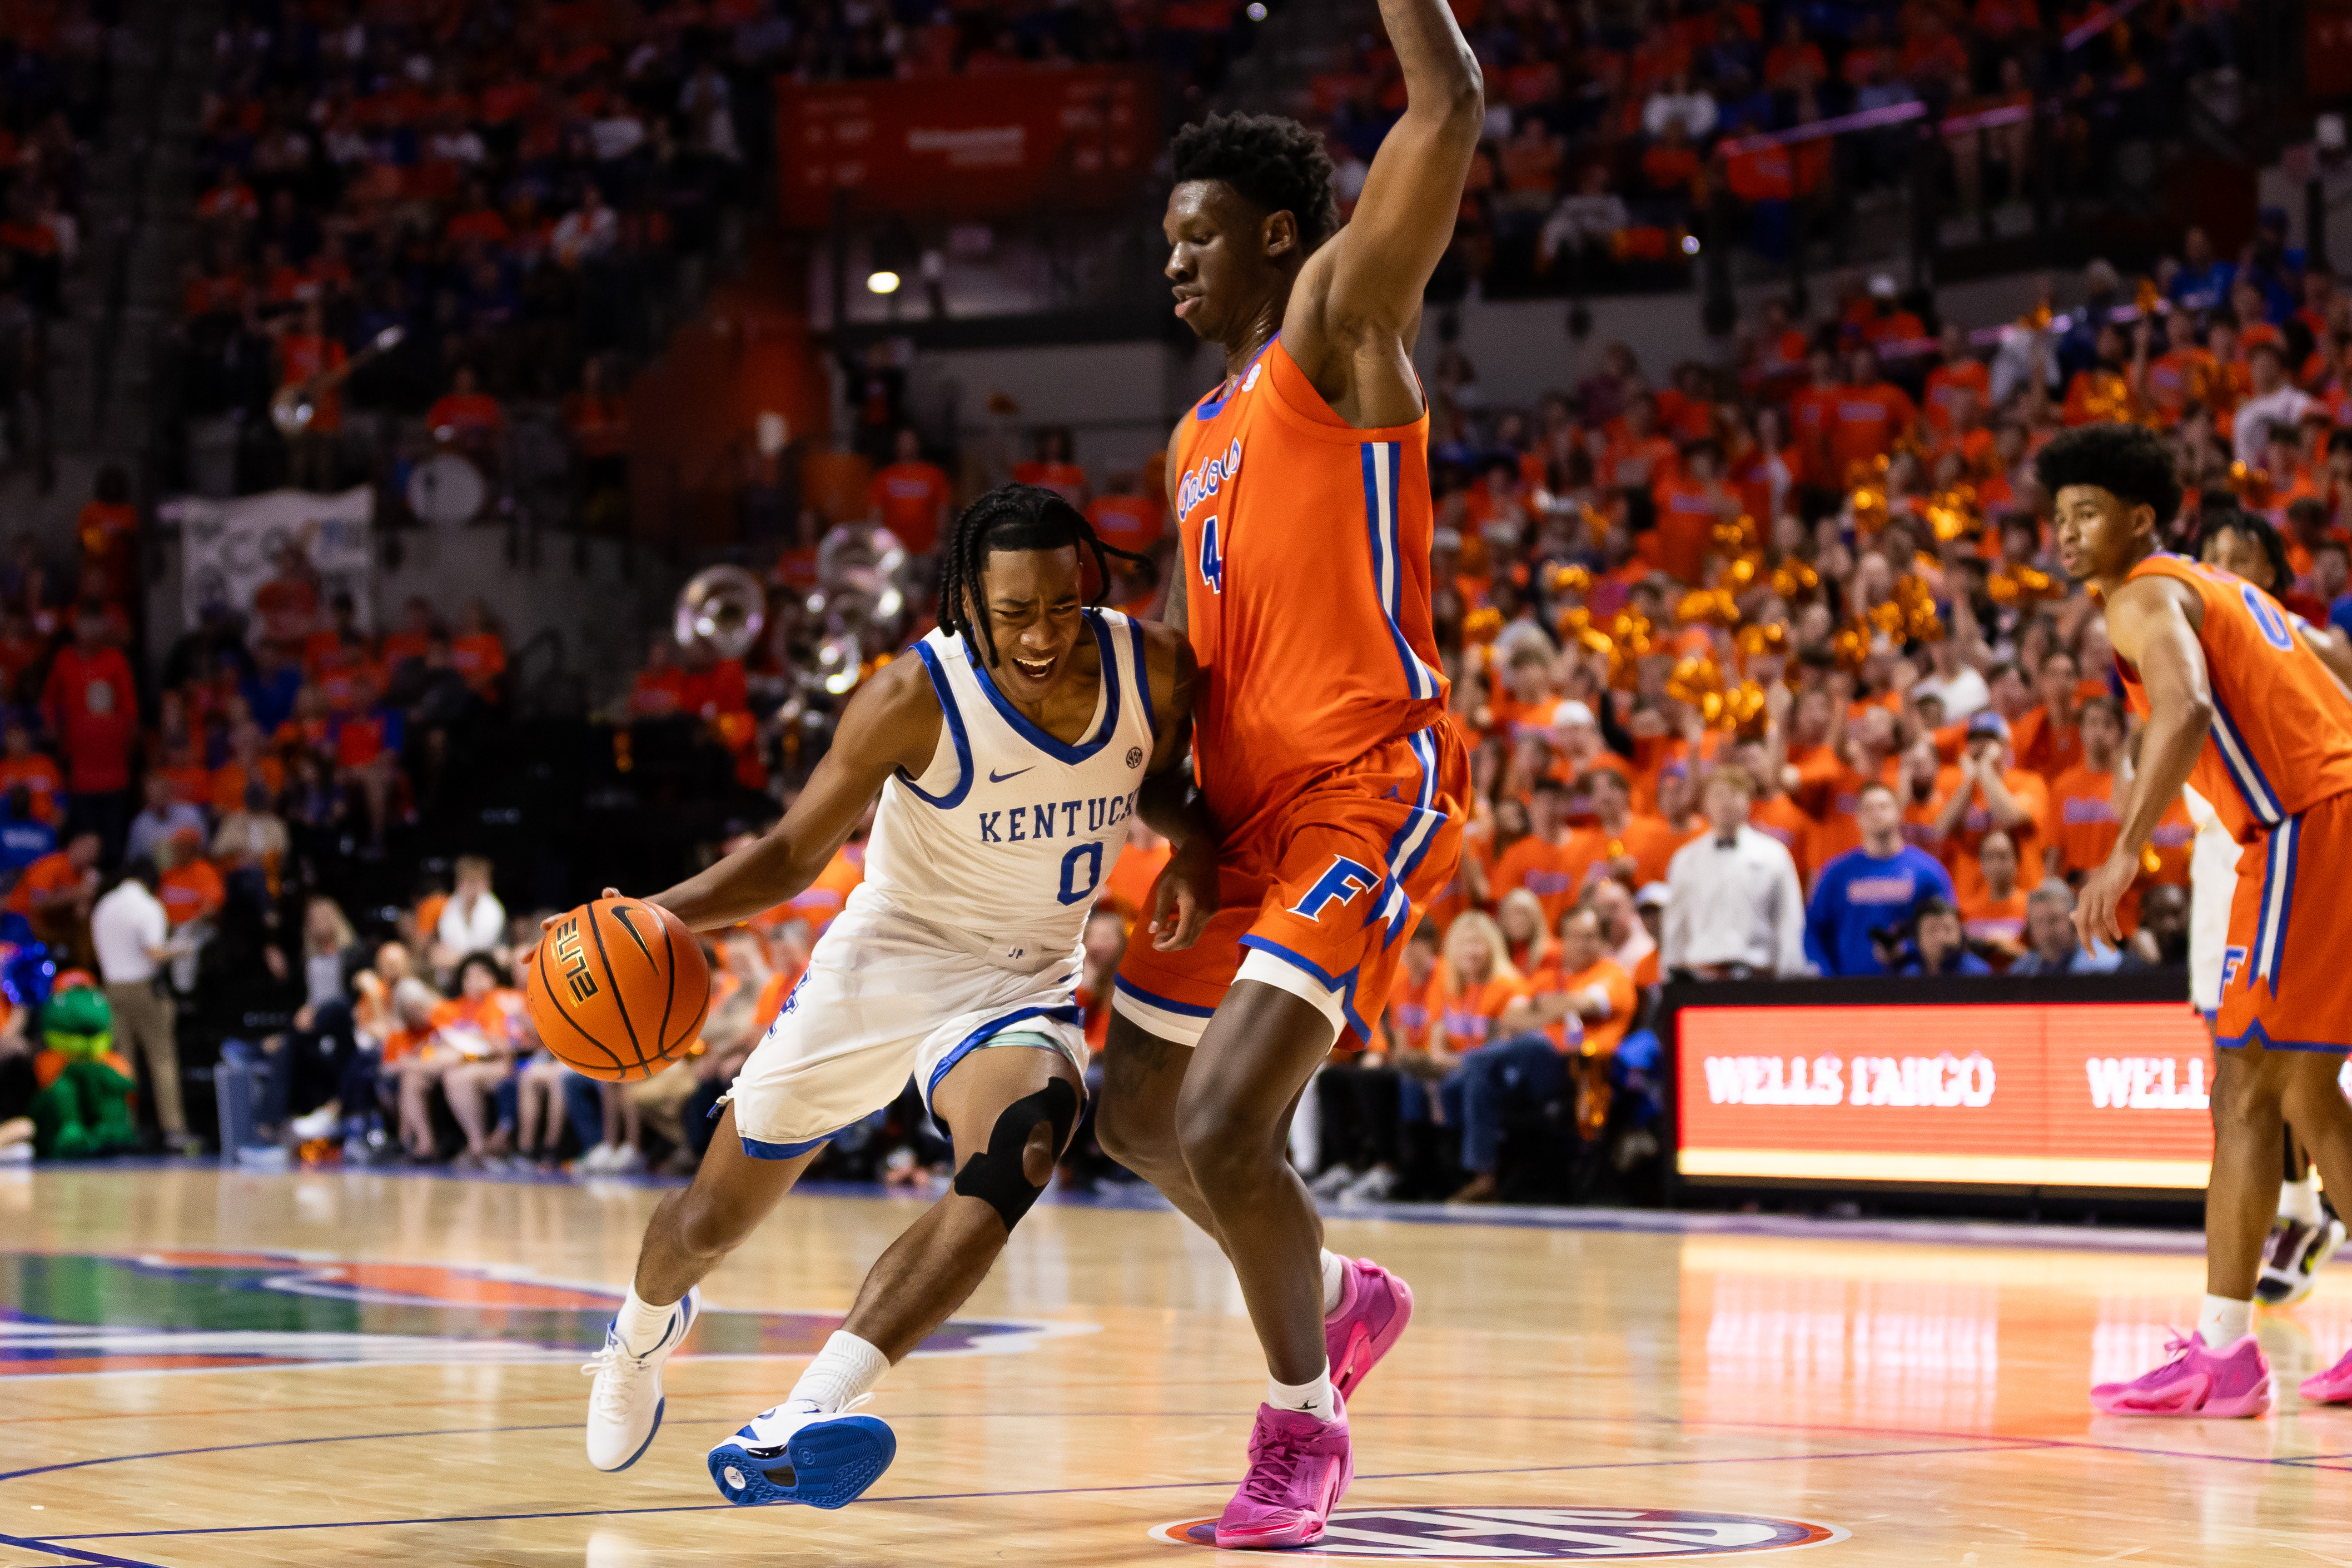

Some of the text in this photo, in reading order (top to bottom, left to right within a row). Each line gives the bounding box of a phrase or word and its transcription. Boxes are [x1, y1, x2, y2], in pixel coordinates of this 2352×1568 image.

[1178, 437, 1241, 522] Gators
[1200, 515, 1222, 594] 4
[2241, 583, 2294, 651] 0
[1127, 748, 1142, 768] SEC
[979, 787, 1138, 843] KENTUCK
[1057, 842, 1103, 906] 0
[1286, 854, 1382, 923] F
[556, 917, 599, 1004] ELITE
[1704, 1051, 1996, 1107] WELLS FARGO
[2086, 1057, 2210, 1109] WELL
